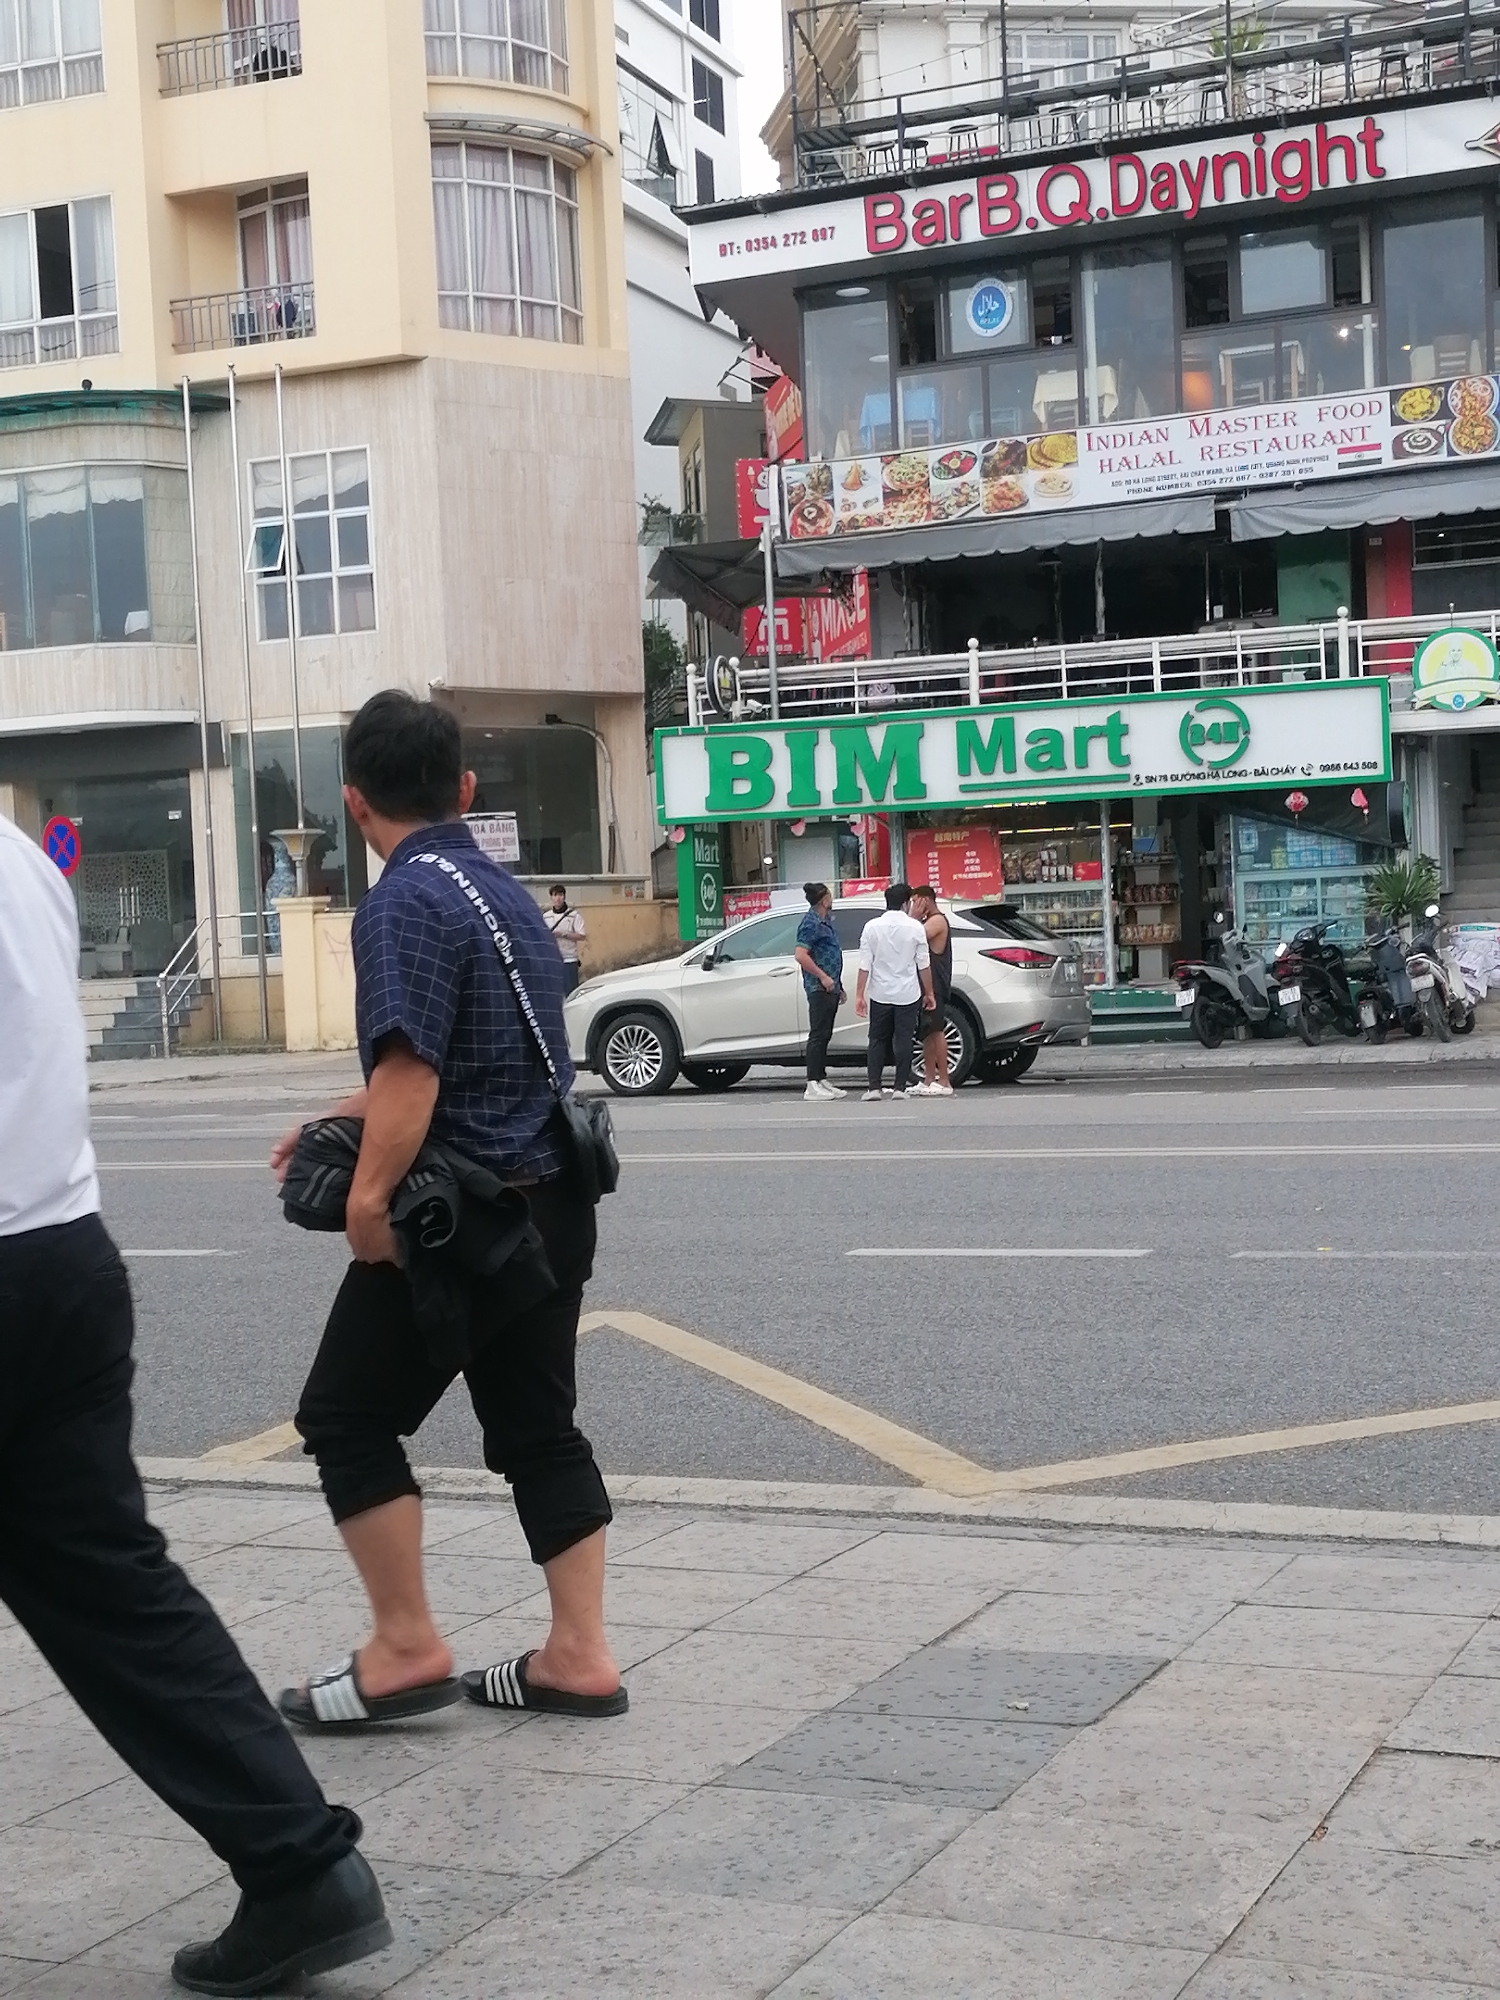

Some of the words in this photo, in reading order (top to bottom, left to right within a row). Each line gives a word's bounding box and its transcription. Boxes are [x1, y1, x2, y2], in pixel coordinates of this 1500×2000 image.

[745, 236, 777, 253] 0354
[783, 231, 807, 248] 272
[1086, 427, 1170, 452] INDIAN
[1188, 411, 1298, 440] MASTER
[1317, 400, 1383, 423] FOOD
[1099, 450, 1182, 474] HALAL
[1200, 425, 1371, 462] RESTAURANT
[704, 722, 927, 811] BIM
[956, 710, 1131, 776] Mart
[1222, 769, 1247, 779] LONG
[694, 838, 720, 864] Mart
